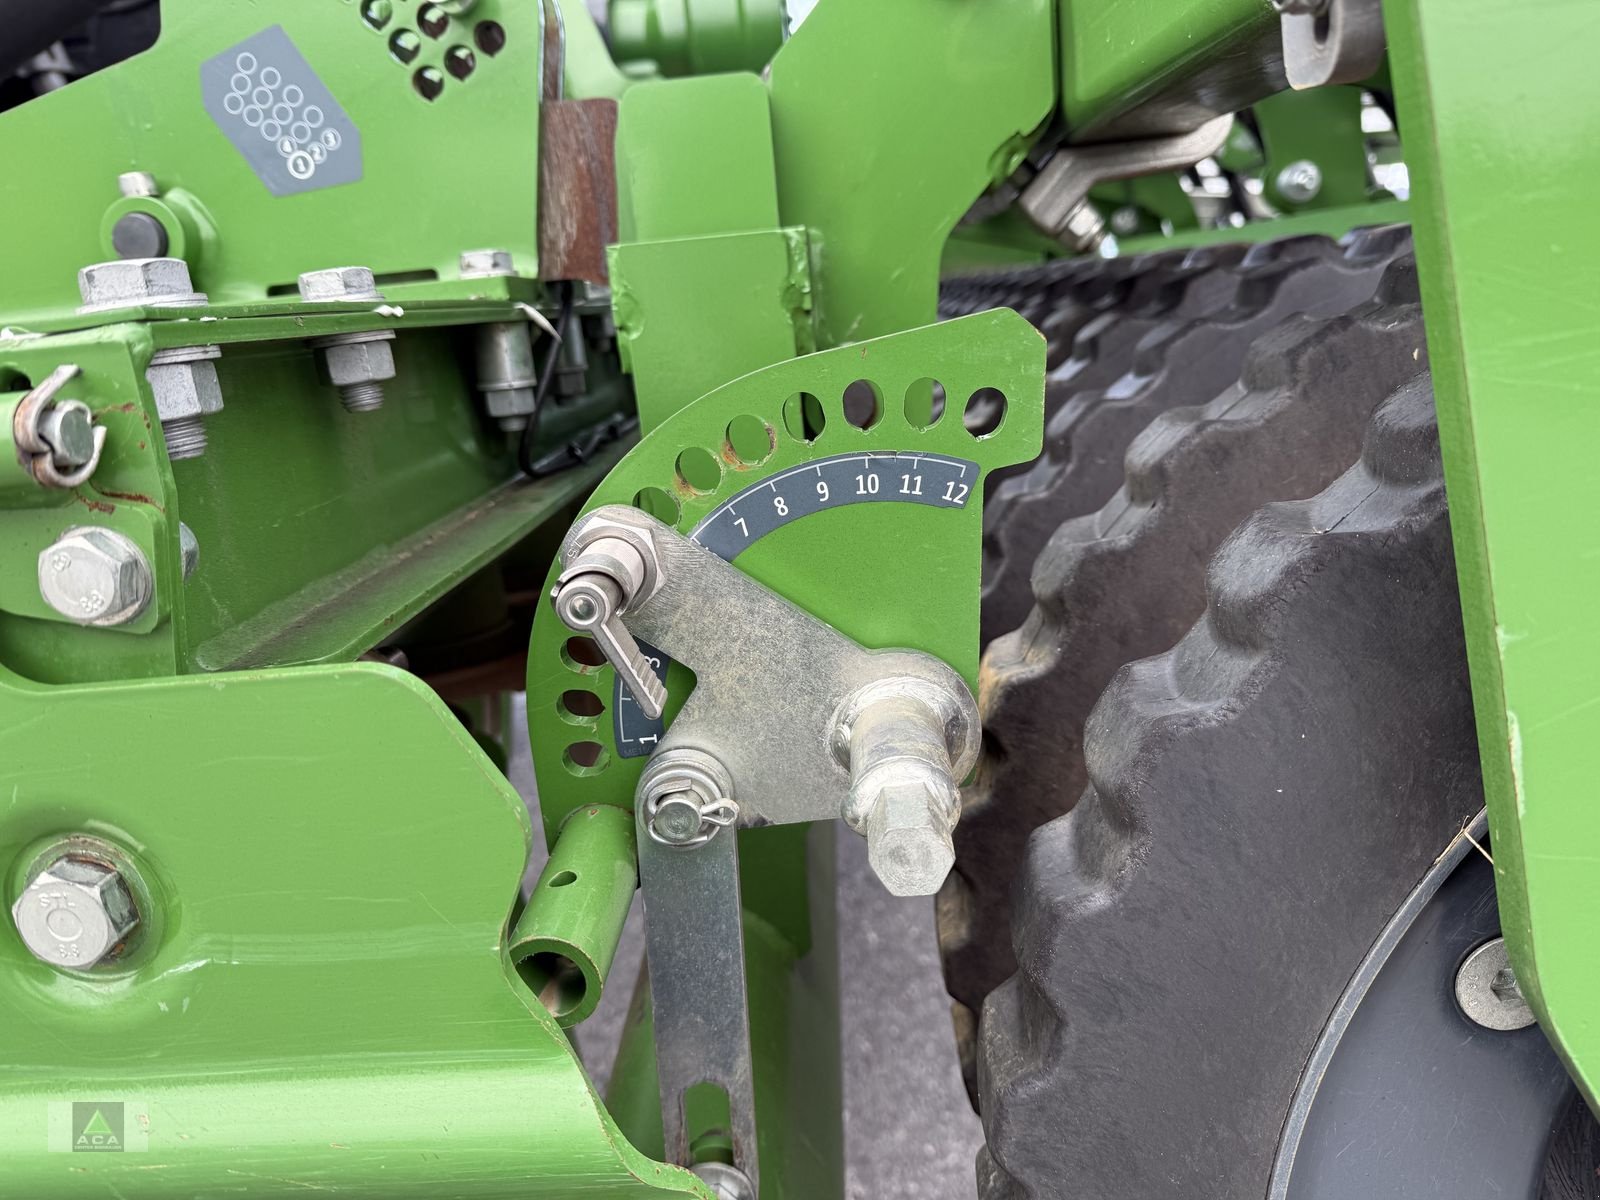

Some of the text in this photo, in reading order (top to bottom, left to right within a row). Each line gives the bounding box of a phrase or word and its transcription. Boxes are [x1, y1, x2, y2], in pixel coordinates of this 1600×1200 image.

[733, 473, 969, 537] 7 8 9 10 11 12
[639, 733, 658, 745] 1
